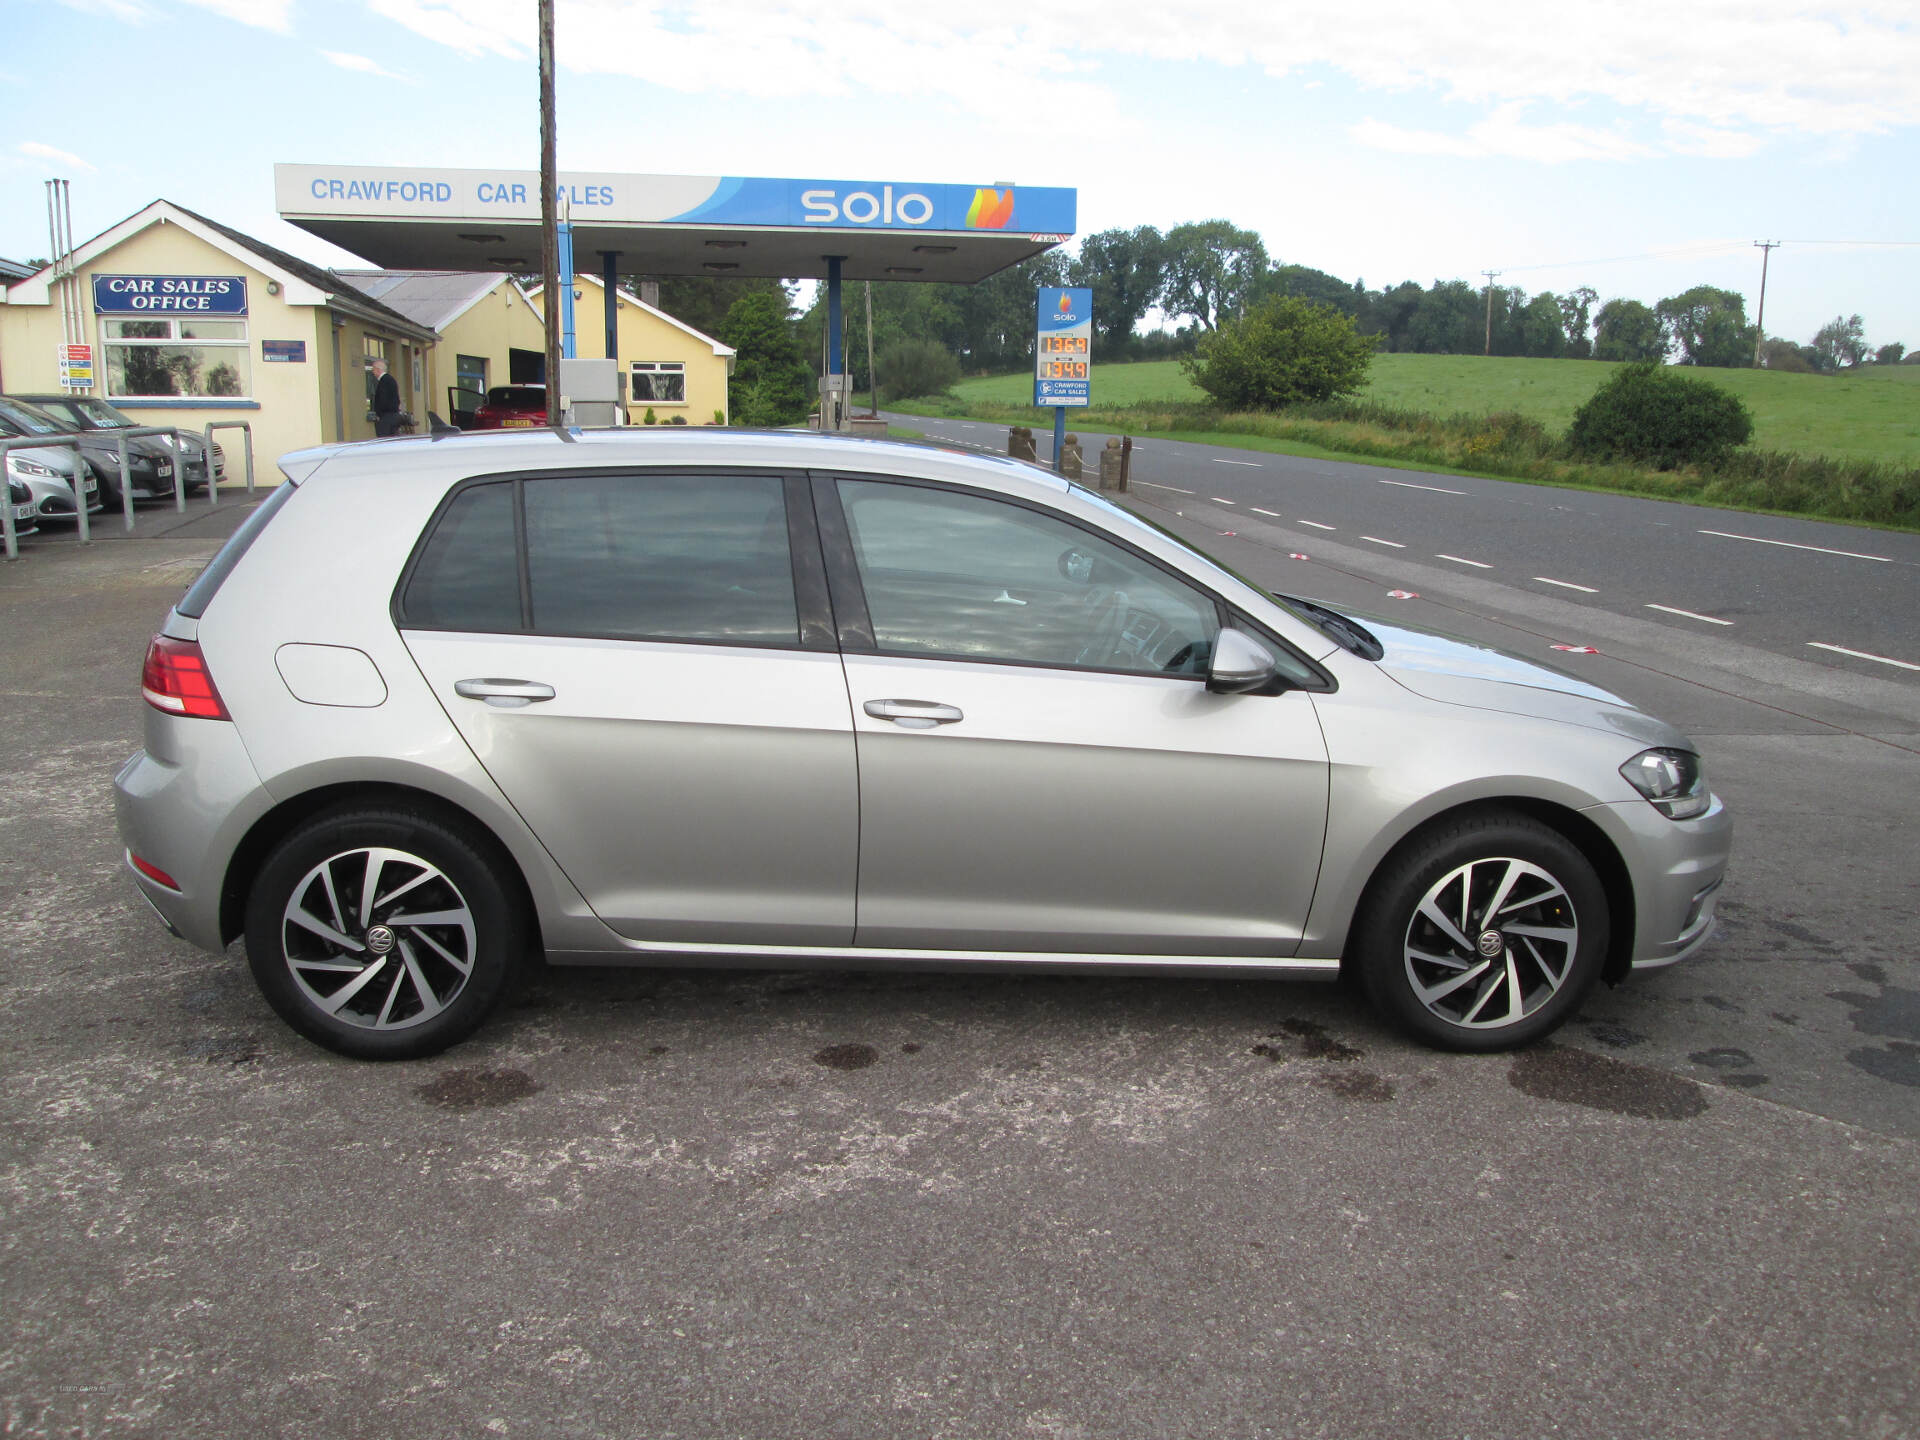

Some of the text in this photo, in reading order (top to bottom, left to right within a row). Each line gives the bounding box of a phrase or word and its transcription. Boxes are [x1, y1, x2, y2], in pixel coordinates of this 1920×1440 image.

[311, 179, 614, 206] CRAWFORD CAR ALES
[801, 185, 934, 225] solo
[109, 279, 230, 294] CAR SALES
[131, 295, 211, 309] OFFICE
[1053, 313, 1077, 321] solo
